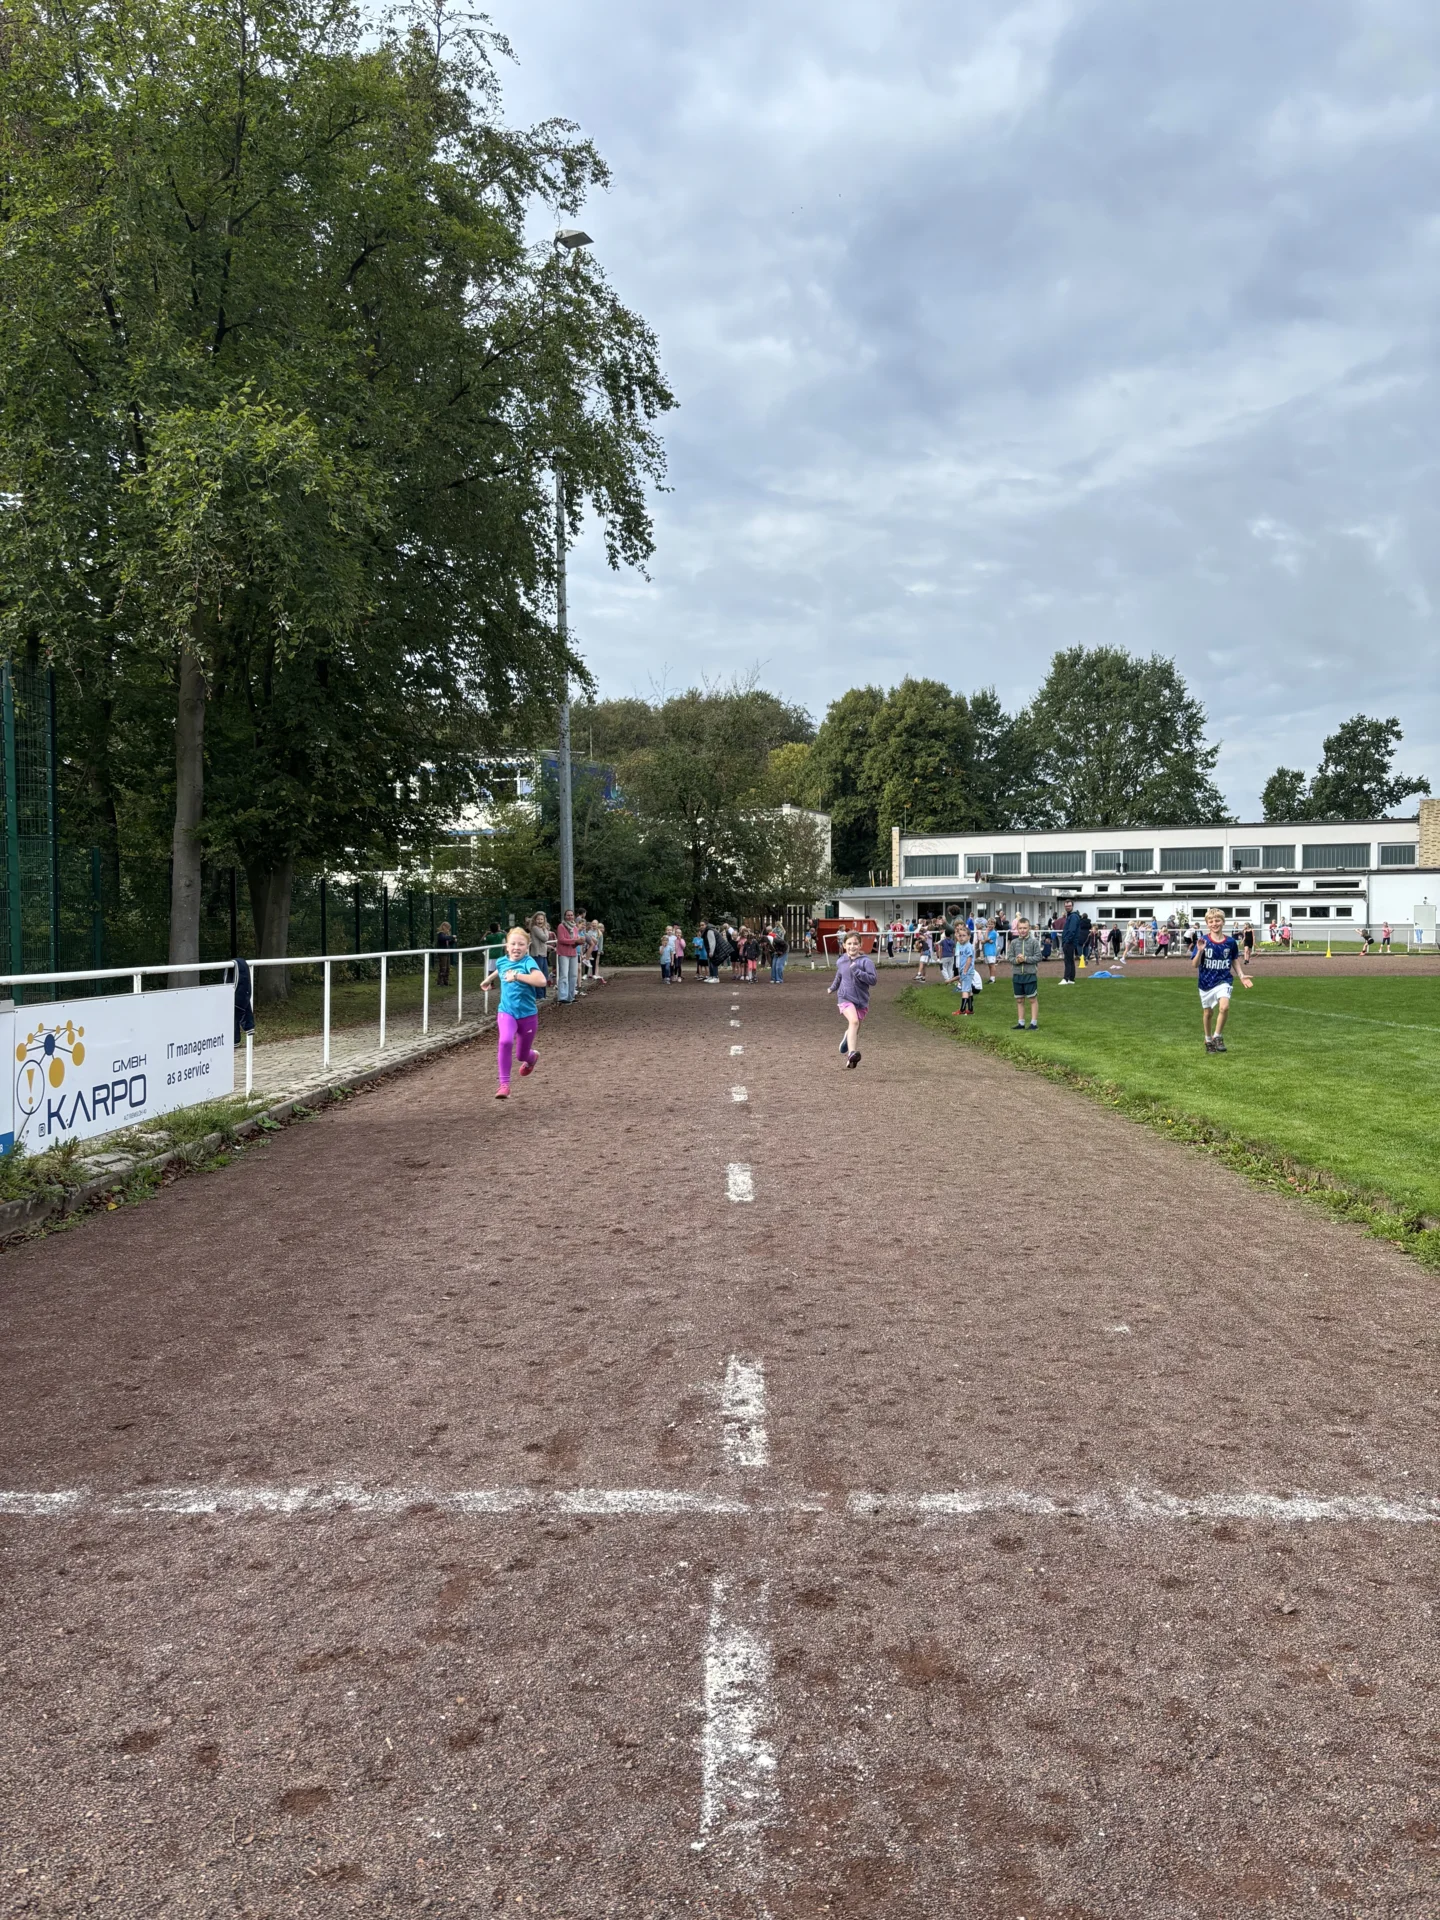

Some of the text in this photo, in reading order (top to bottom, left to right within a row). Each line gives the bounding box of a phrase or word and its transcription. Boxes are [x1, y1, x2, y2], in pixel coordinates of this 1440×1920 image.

[166, 1033, 225, 1060] IT management
[112, 1054, 147, 1073] GMBH
[166, 1061, 210, 1085] as a service
[47, 1074, 146, 1135] KARPO
